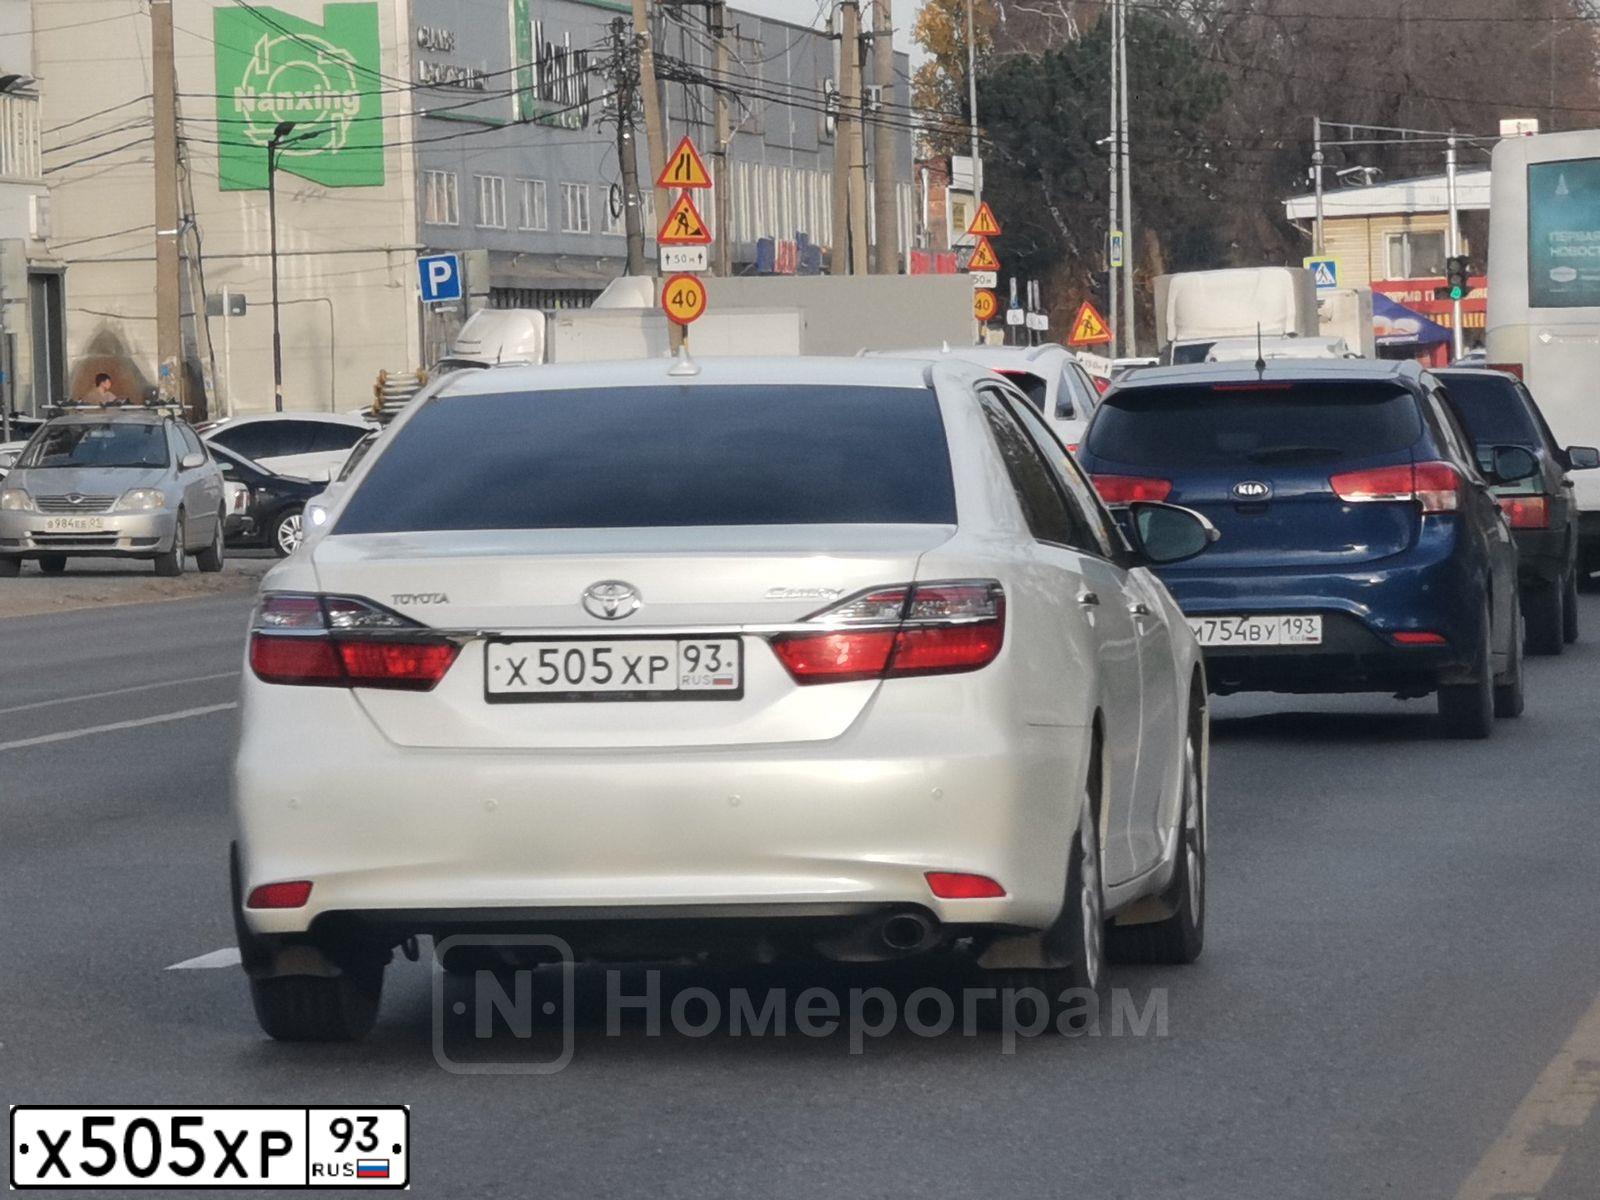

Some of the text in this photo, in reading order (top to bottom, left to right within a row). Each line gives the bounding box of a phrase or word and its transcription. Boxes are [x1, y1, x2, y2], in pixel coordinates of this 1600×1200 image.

[234, 84, 360, 116] Nanxing
[674, 254, 687, 264] 50
[428, 260, 452, 297] P
[671, 289, 697, 308] 40
[974, 298, 990, 311] 40
[1238, 484, 1264, 496] KIA
[391, 592, 451, 606] TOYOTA
[1282, 617, 1317, 634] 193
[683, 644, 722, 673] 93
[682, 675, 711, 685] RUS
